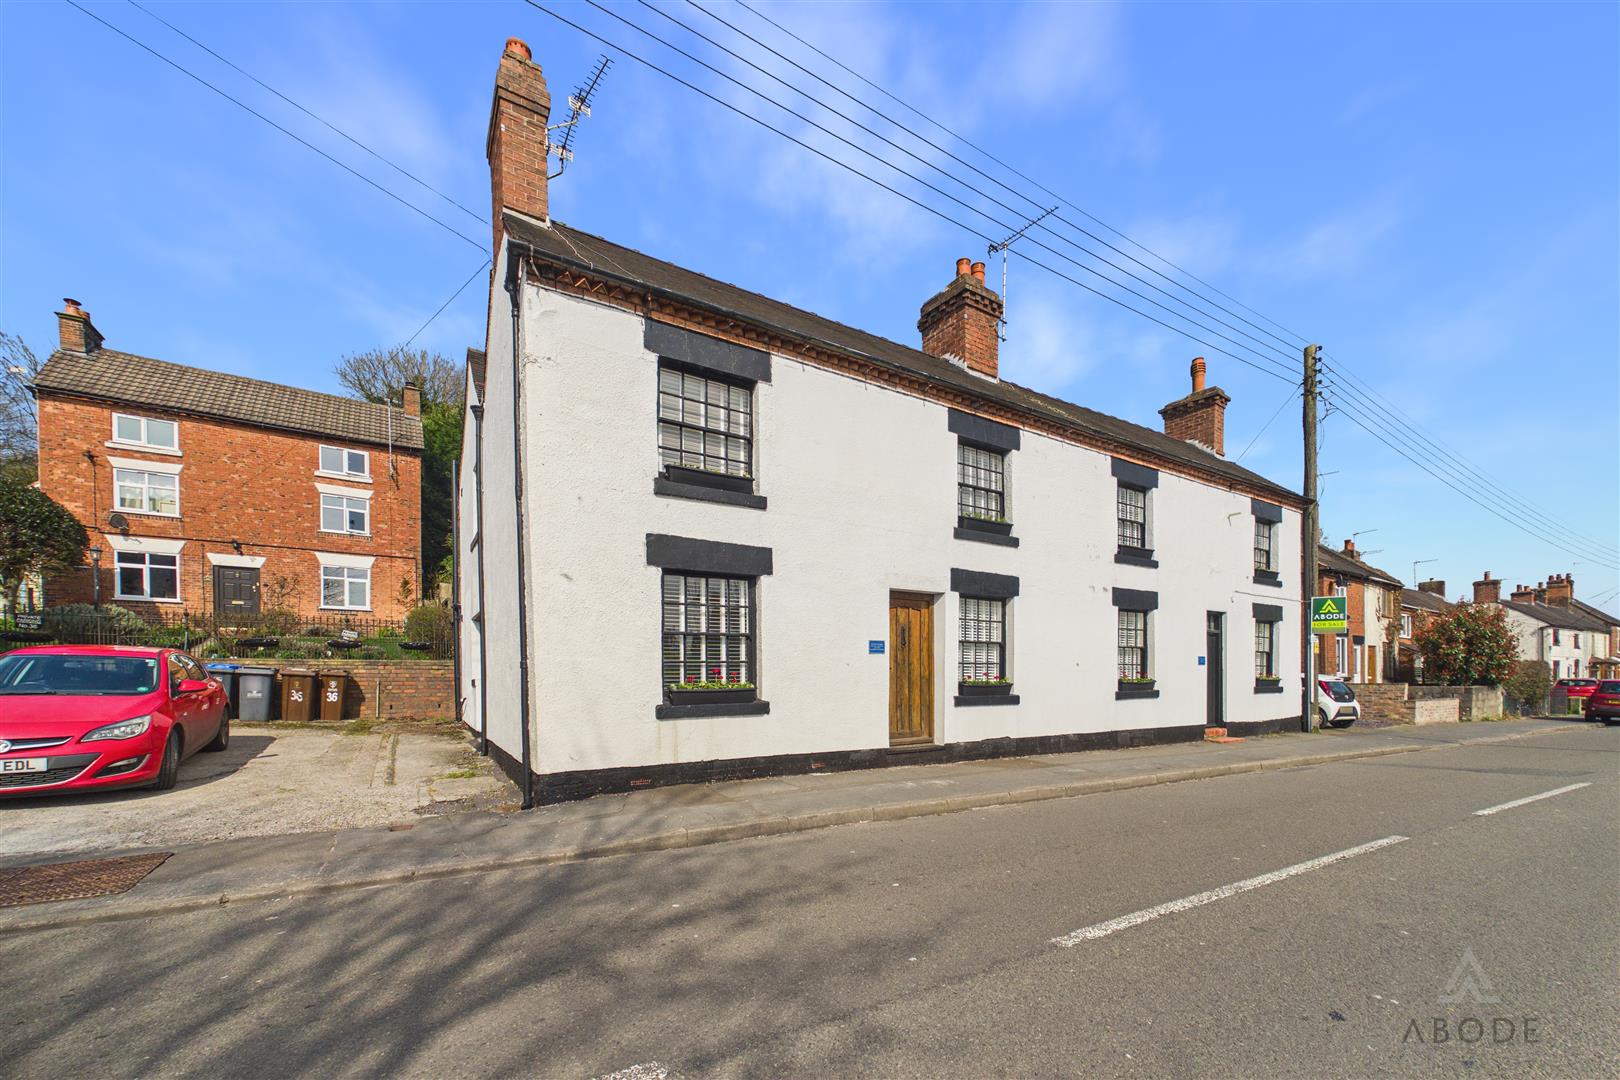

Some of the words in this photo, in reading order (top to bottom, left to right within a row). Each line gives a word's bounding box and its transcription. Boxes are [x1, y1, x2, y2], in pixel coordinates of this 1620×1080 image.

[291, 689, 304, 702] 36
[326, 692, 338, 702] 36
[3, 760, 36, 771] EDL
